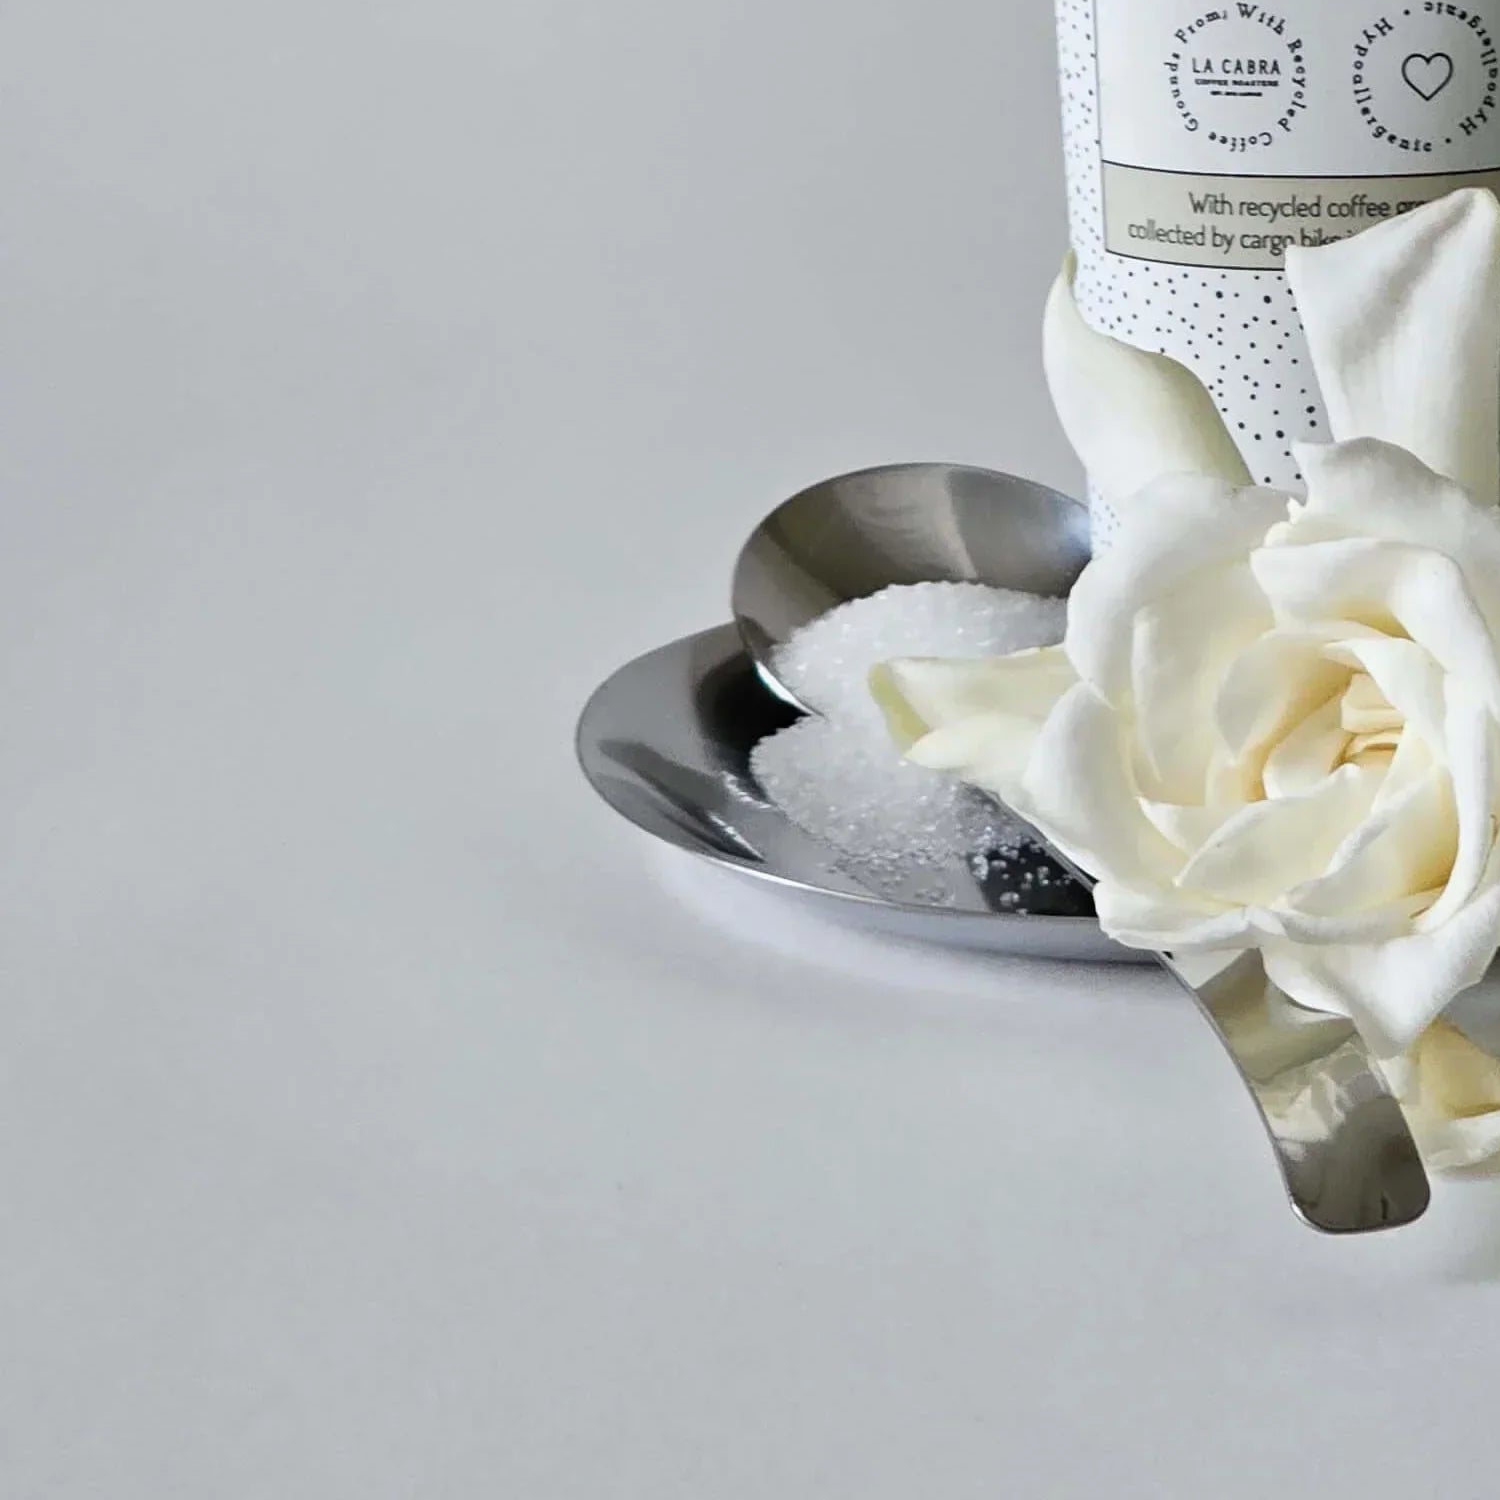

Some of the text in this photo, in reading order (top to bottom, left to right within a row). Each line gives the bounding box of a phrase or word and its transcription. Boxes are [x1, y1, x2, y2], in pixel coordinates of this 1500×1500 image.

[1236, 2, 1286, 36] With
[1191, 57, 1282, 75] LA CABRA
[1352, 1, 1499, 152] Hypoallergenic Hypoallergenic
[1163, 52, 1199, 132] Grounds
[1277, 38, 1308, 132] Recycled
[1207, 131, 1273, 153] Coffee
[1188, 191, 1233, 216] With
[1239, 194, 1322, 224] recycled
[1326, 194, 1391, 218] coffee
[1127, 219, 1205, 247] collected
[1211, 225, 1236, 254] by
[1239, 234, 1297, 256] cargo
